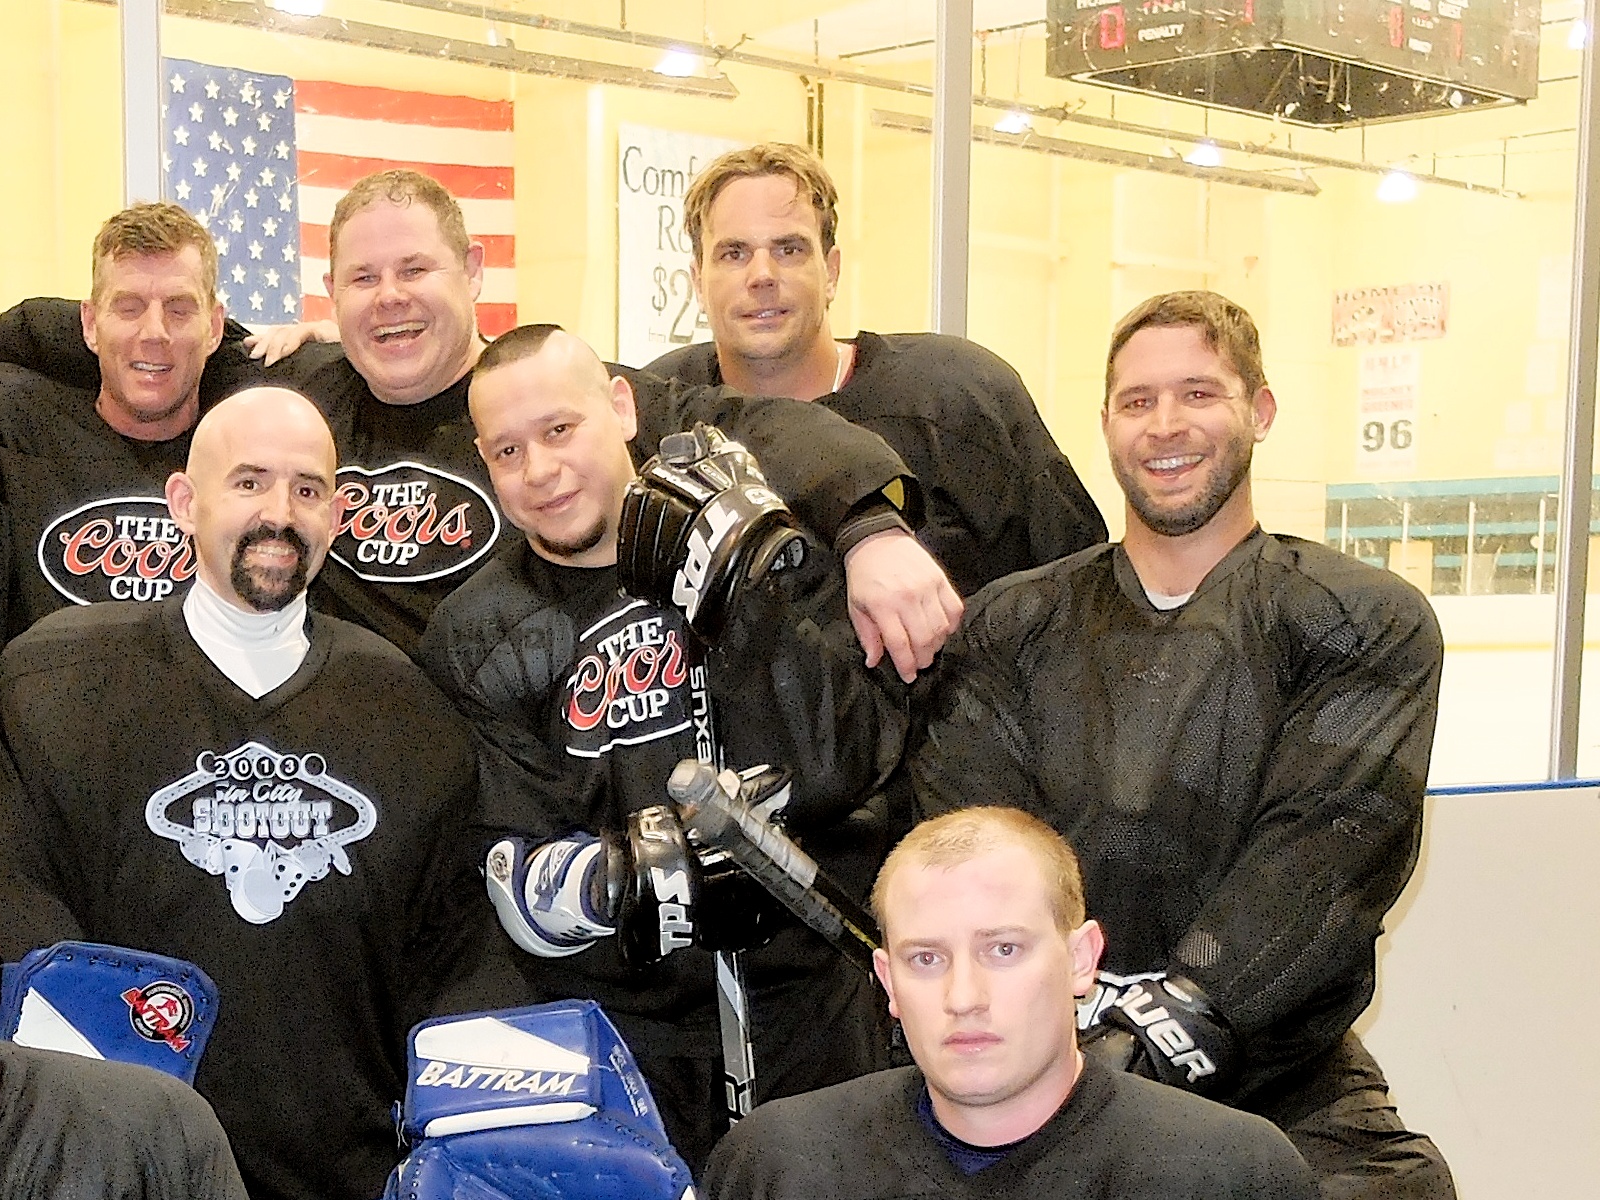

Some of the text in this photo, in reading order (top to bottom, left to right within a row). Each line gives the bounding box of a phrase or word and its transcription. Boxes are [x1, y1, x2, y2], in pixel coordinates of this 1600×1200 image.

[622, 146, 699, 198] Comf
[1361, 419, 1413, 452] 96
[372, 481, 428, 507] THE
[116, 516, 180, 543] THE
[59, 518, 198, 582] Coor
[357, 539, 420, 566] CUP
[109, 576, 174, 602] CUP
[597, 616, 665, 666] THE
[605, 688, 670, 729] CUP
[690, 665, 712, 765] EXUS
[213, 758, 296, 777] 2013
[650, 866, 694, 957] TPS
[416, 1060, 576, 1097] BATTRAM
